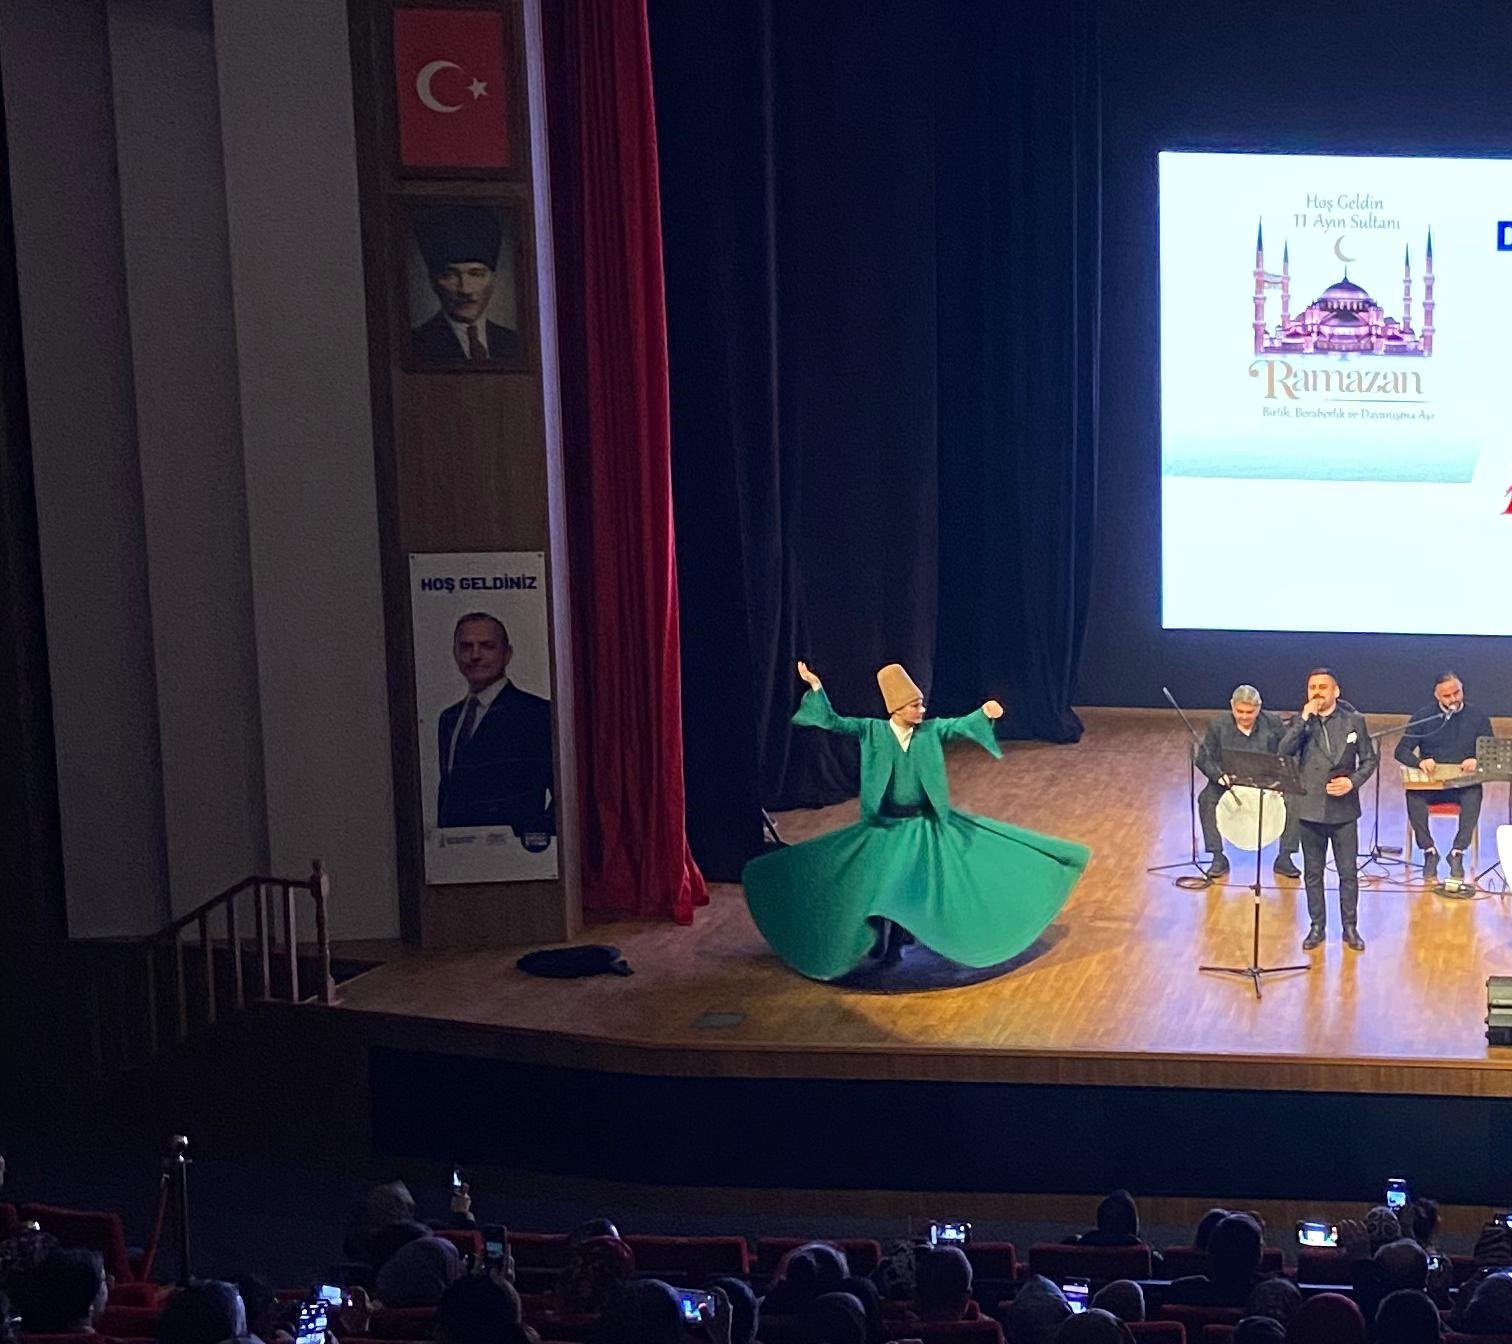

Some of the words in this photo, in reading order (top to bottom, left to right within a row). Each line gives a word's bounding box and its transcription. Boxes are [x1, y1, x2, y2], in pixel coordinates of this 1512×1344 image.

[1306, 193, 1333, 213] Hoş
[1337, 193, 1384, 211] Geldin
[1313, 214, 1346, 233] Ayın
[1350, 212, 1401, 230] Sultanı
[1248, 359, 1424, 400] Ramazan
[421, 577, 456, 593] HOŞ
[460, 573, 537, 590] GELDİNİZ
